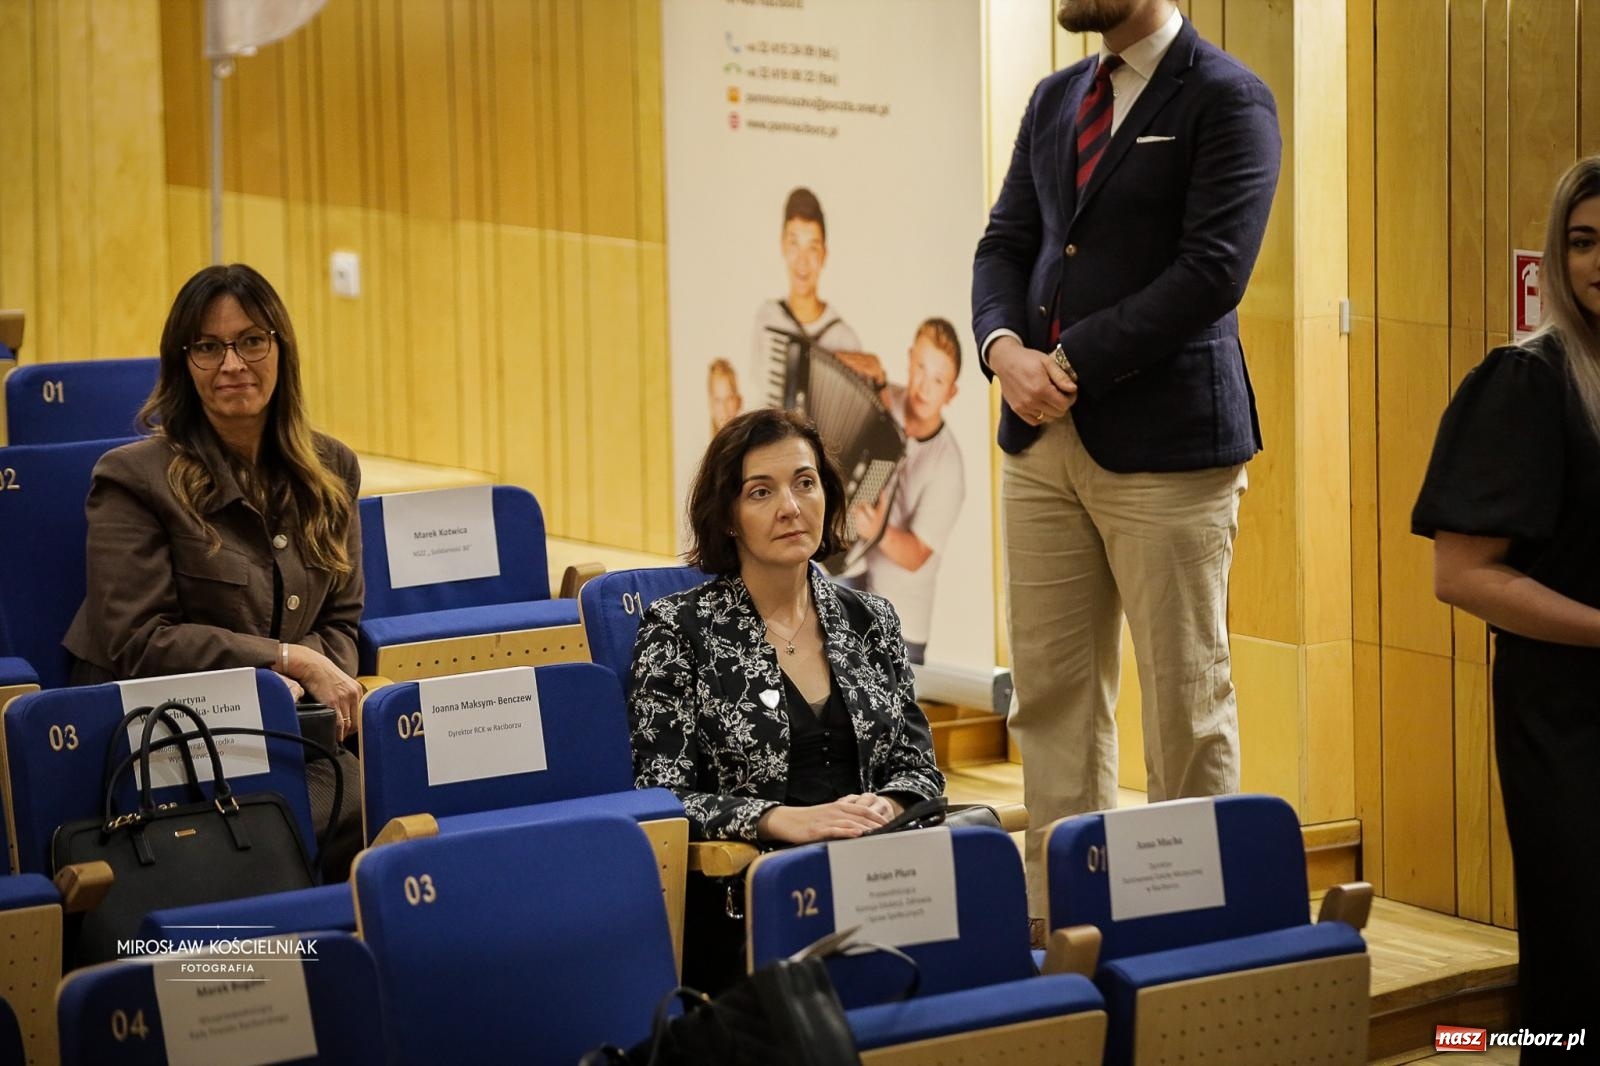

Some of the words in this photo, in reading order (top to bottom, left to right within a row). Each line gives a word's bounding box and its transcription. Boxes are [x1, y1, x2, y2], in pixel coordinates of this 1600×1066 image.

[42, 380, 65, 404] 01
[413, 530, 438, 540] Marek
[439, 526, 468, 537] Kotwica
[622, 591, 645, 620] 01
[212, 703, 241, 714] Urban
[431, 703, 459, 714] Joanna
[460, 699, 497, 710] Maksym-
[497, 694, 532, 705] Benczew
[397, 711, 425, 740] 02
[447, 728, 473, 738] Dyrektor
[474, 726, 486, 734] RCK
[493, 721, 522, 732] Raciborzu
[48, 724, 80, 752] 03
[866, 870, 894, 883] Adrian
[404, 874, 436, 906] 03
[111, 1008, 149, 1041] 04
